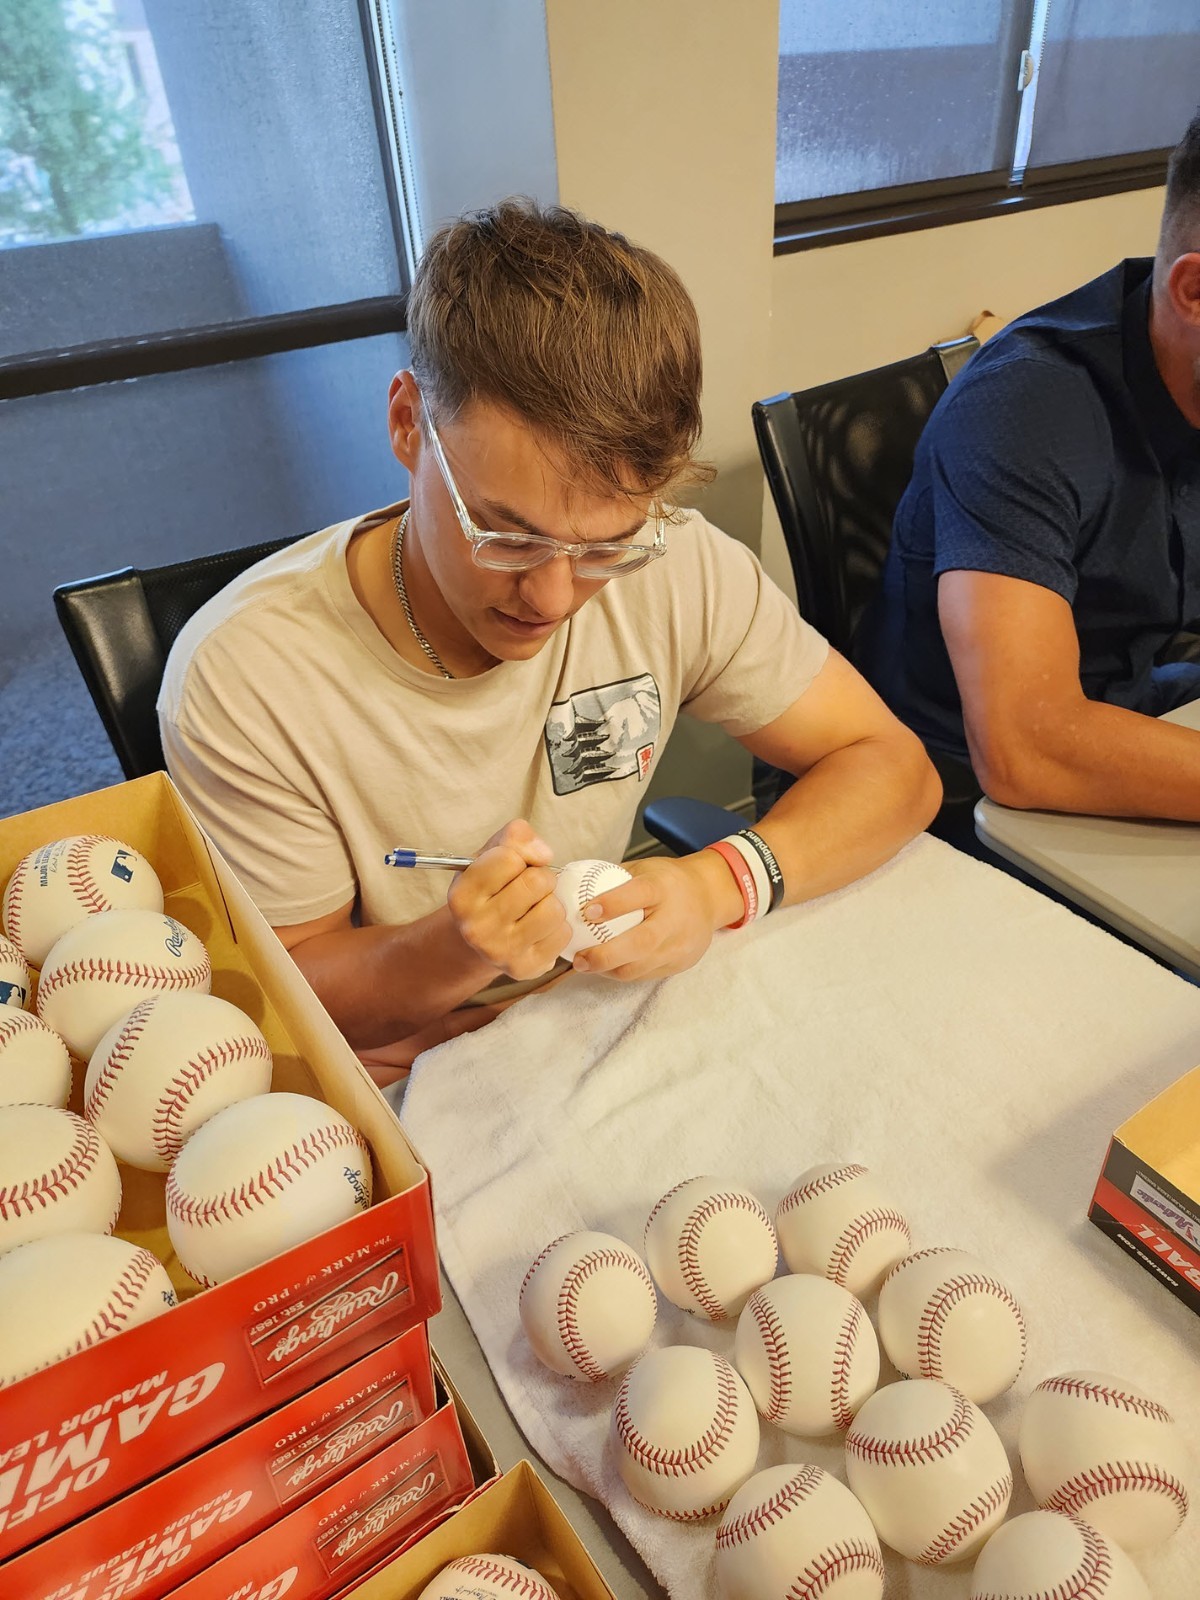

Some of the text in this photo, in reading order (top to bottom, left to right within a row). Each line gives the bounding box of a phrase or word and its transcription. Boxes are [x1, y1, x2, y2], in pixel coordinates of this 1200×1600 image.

[746, 831, 779, 876] Philippians
[40, 865, 48, 887] MAJOR
[373, 1235, 391, 1247] The
[1137, 1223, 1200, 1290] BALL
[321, 1244, 370, 1277] MARK
[1116, 1233, 1179, 1288] RAWLINGS.COM
[305, 1274, 317, 1286] of
[253, 1287, 291, 1313] PRO
[267, 1271, 399, 1362] Rawlings
[250, 1300, 306, 1336] Est. 1887
[381, 1370, 398, 1383] The
[333, 1381, 379, 1412] MARK
[0, 1370, 168, 1469] MAJOR LEA
[274, 1425, 307, 1449] PRO
[271, 1434, 320, 1469] Est. 1887
[286, 1400, 404, 1487] Rawlings
[371, 1459, 410, 1489] MARK
[0, 1457, 110, 1535] OFFI
[318, 1504, 347, 1527] PRO
[332, 1472, 436, 1558] Rawlings
[340, 1509, 360, 1525] Est.
[78, 1489, 233, 1586] MAJOR LEAGUE
[103, 1490, 253, 1593] GAME
